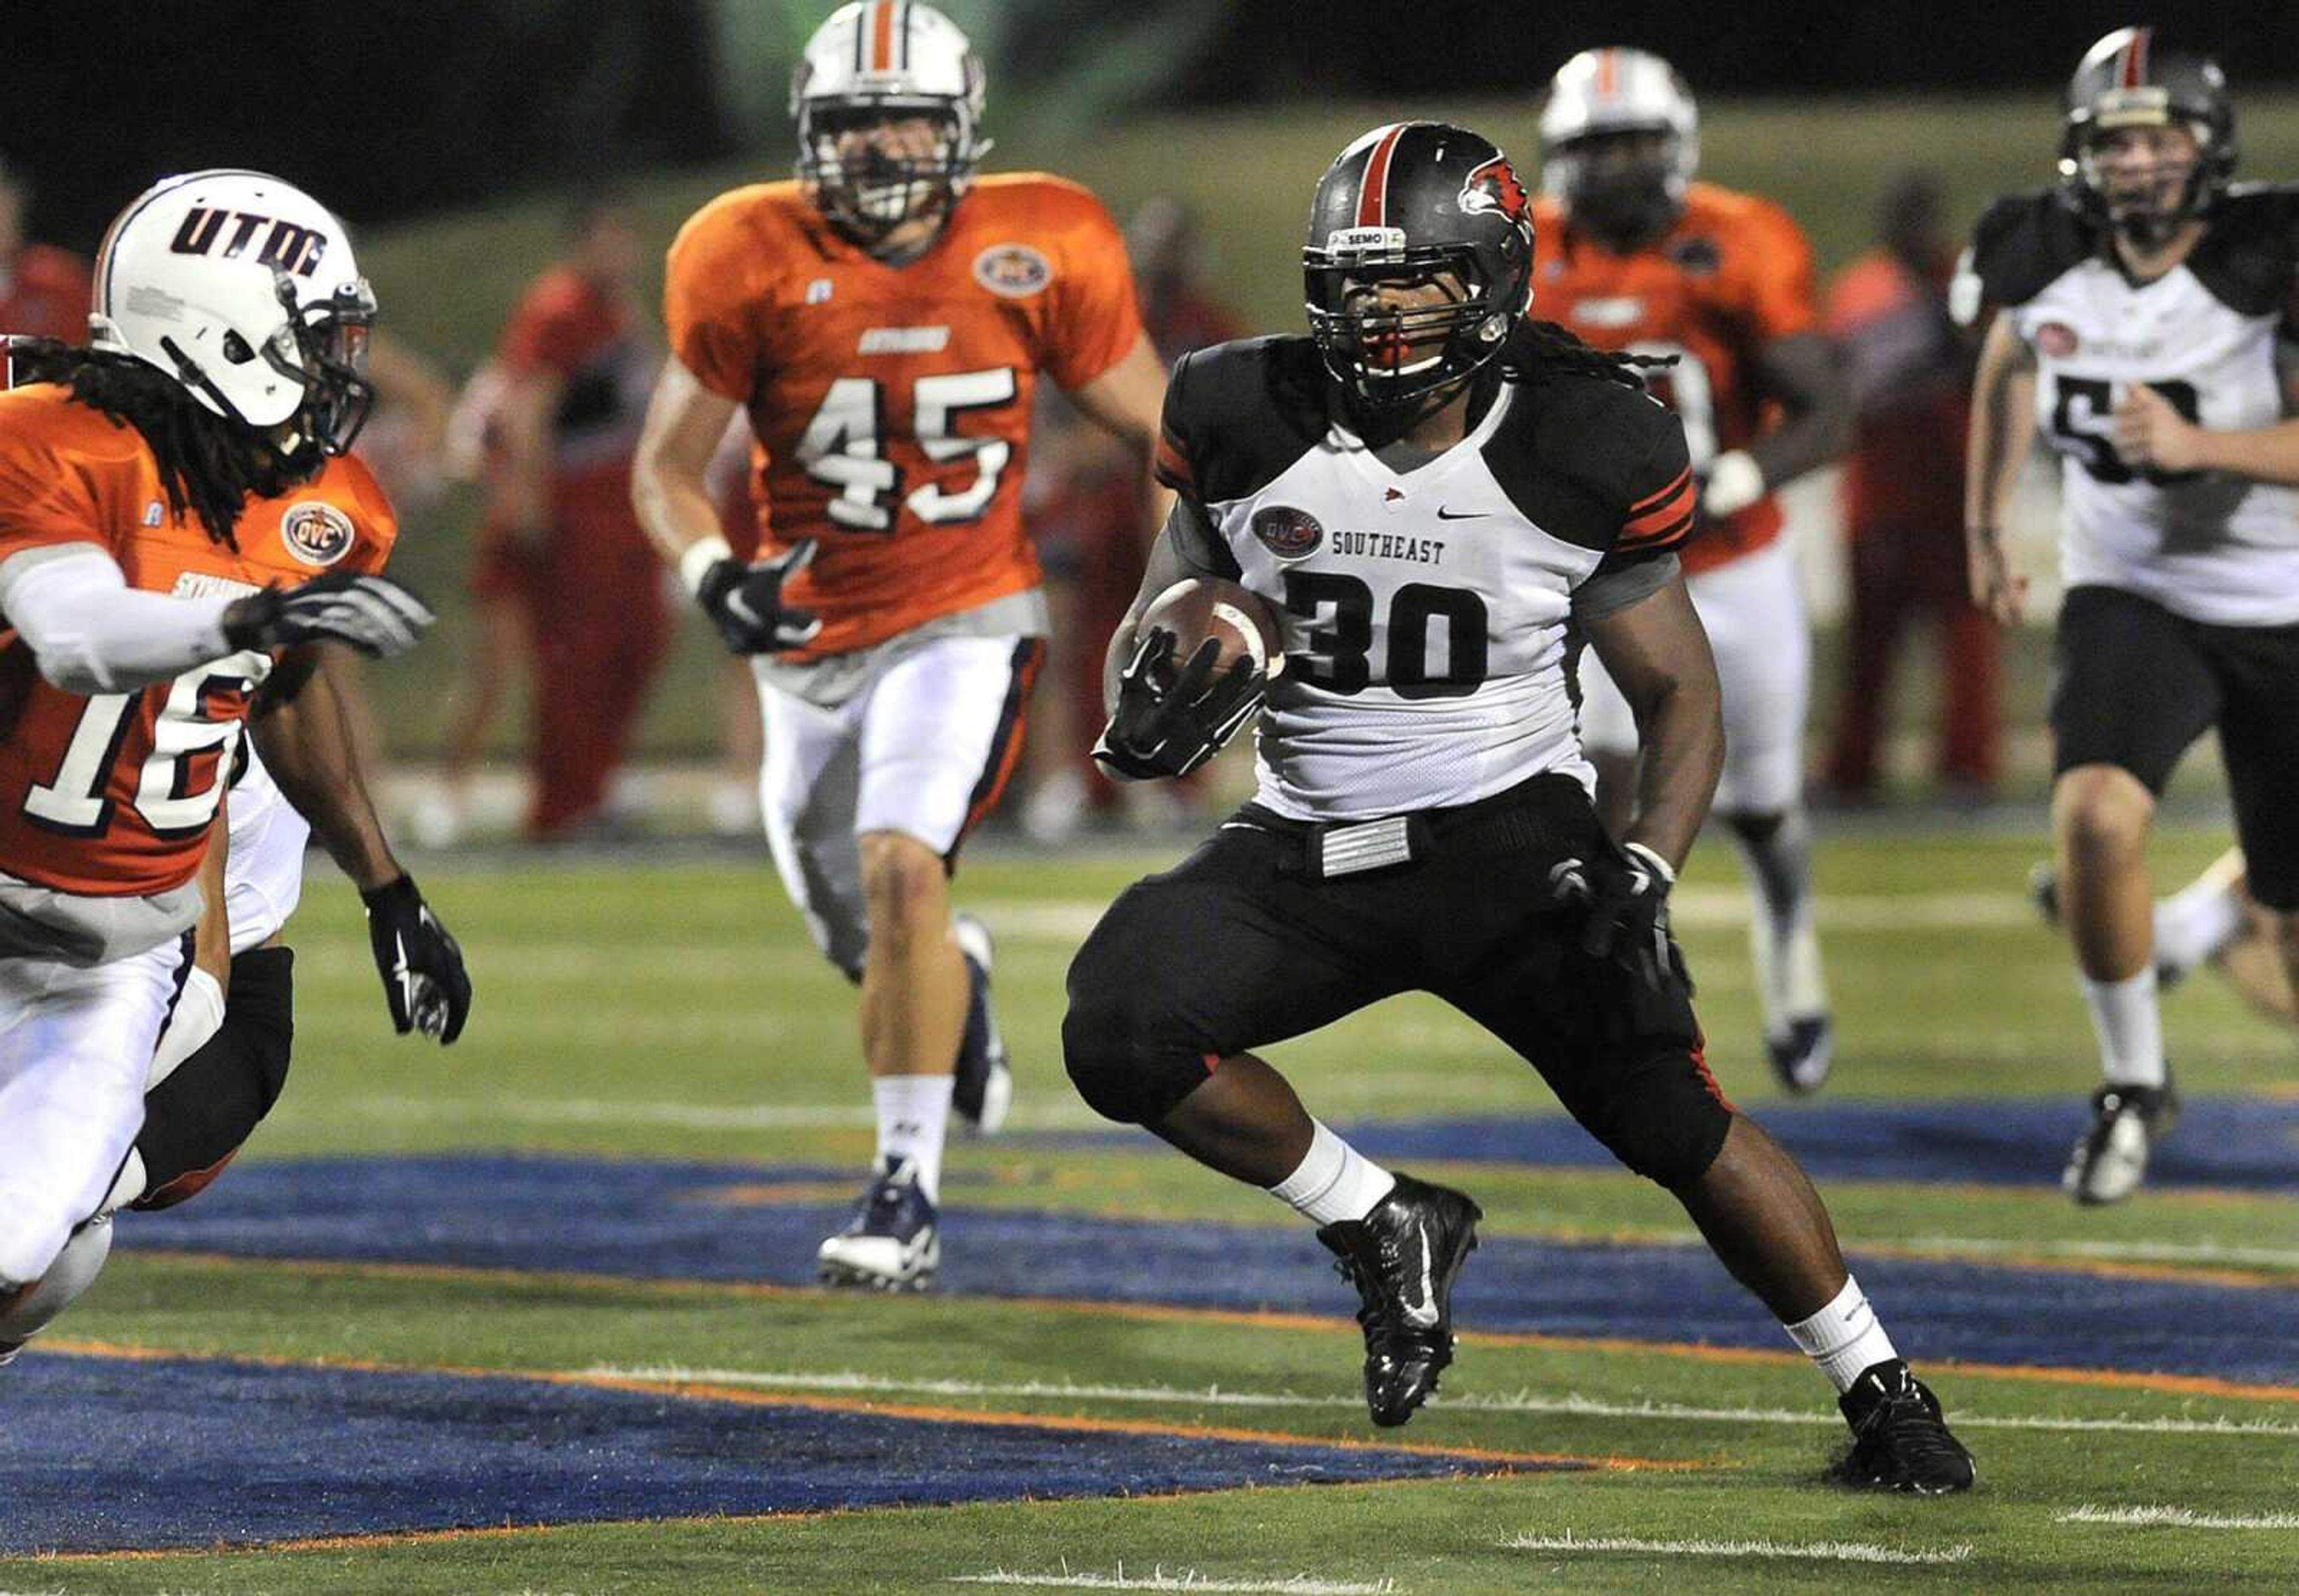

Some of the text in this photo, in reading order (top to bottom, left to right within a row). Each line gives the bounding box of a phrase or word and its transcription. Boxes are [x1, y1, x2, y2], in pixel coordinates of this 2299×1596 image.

[171, 207, 327, 277] UTM
[1349, 233, 1381, 244] SEMO
[795, 367, 1015, 529] 45
[298, 521, 336, 548] OVC
[1333, 531, 1445, 564] SOUTHEAST
[1283, 570, 1488, 699] 30
[23, 650, 273, 841] 16
